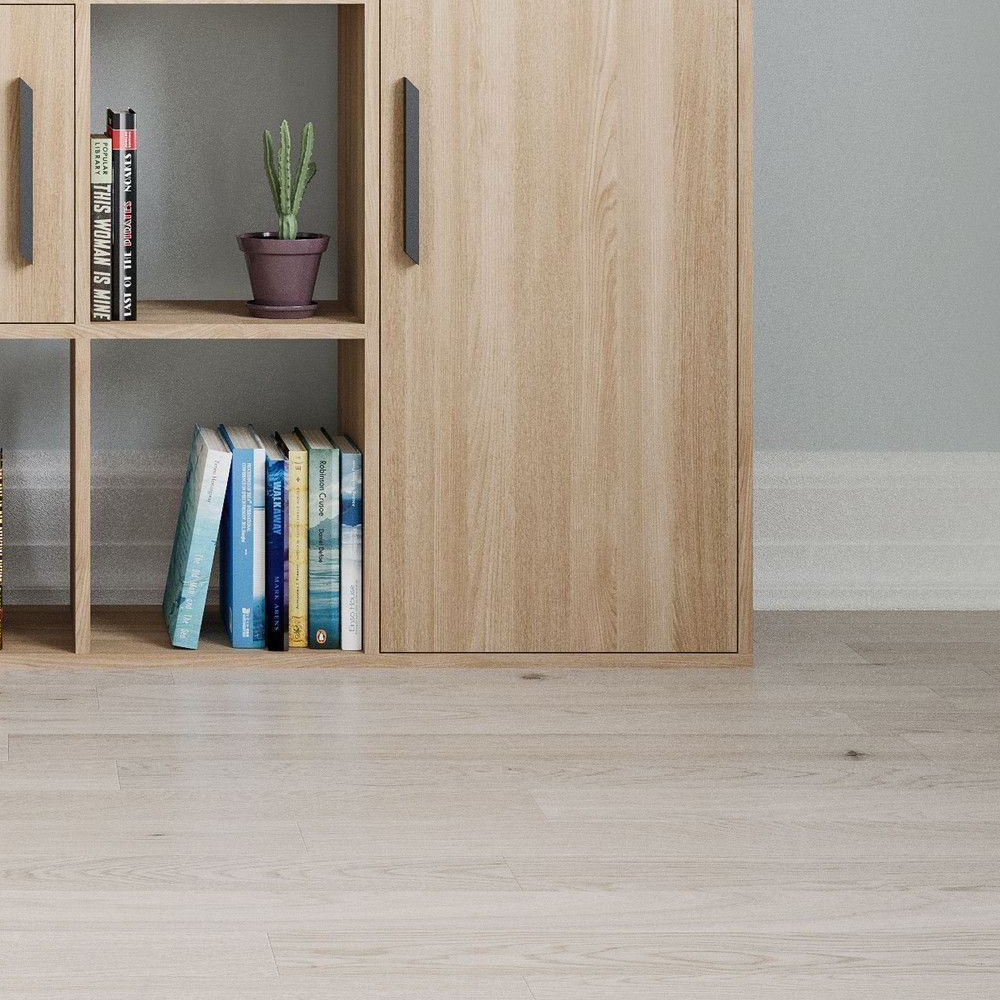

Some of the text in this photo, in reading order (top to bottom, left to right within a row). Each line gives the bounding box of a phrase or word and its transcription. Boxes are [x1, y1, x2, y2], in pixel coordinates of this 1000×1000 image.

[124, 153, 132, 192] NOAKES
[124, 201, 132, 247] PIRATES
[94, 184, 111, 320] THIS WOMAN IS MINE
[124, 251, 132, 270] THE
[124, 292, 132, 316] LAST
[272, 481, 282, 535] WALKAWAY
[318, 460, 327, 517] Robinson Crusoe
